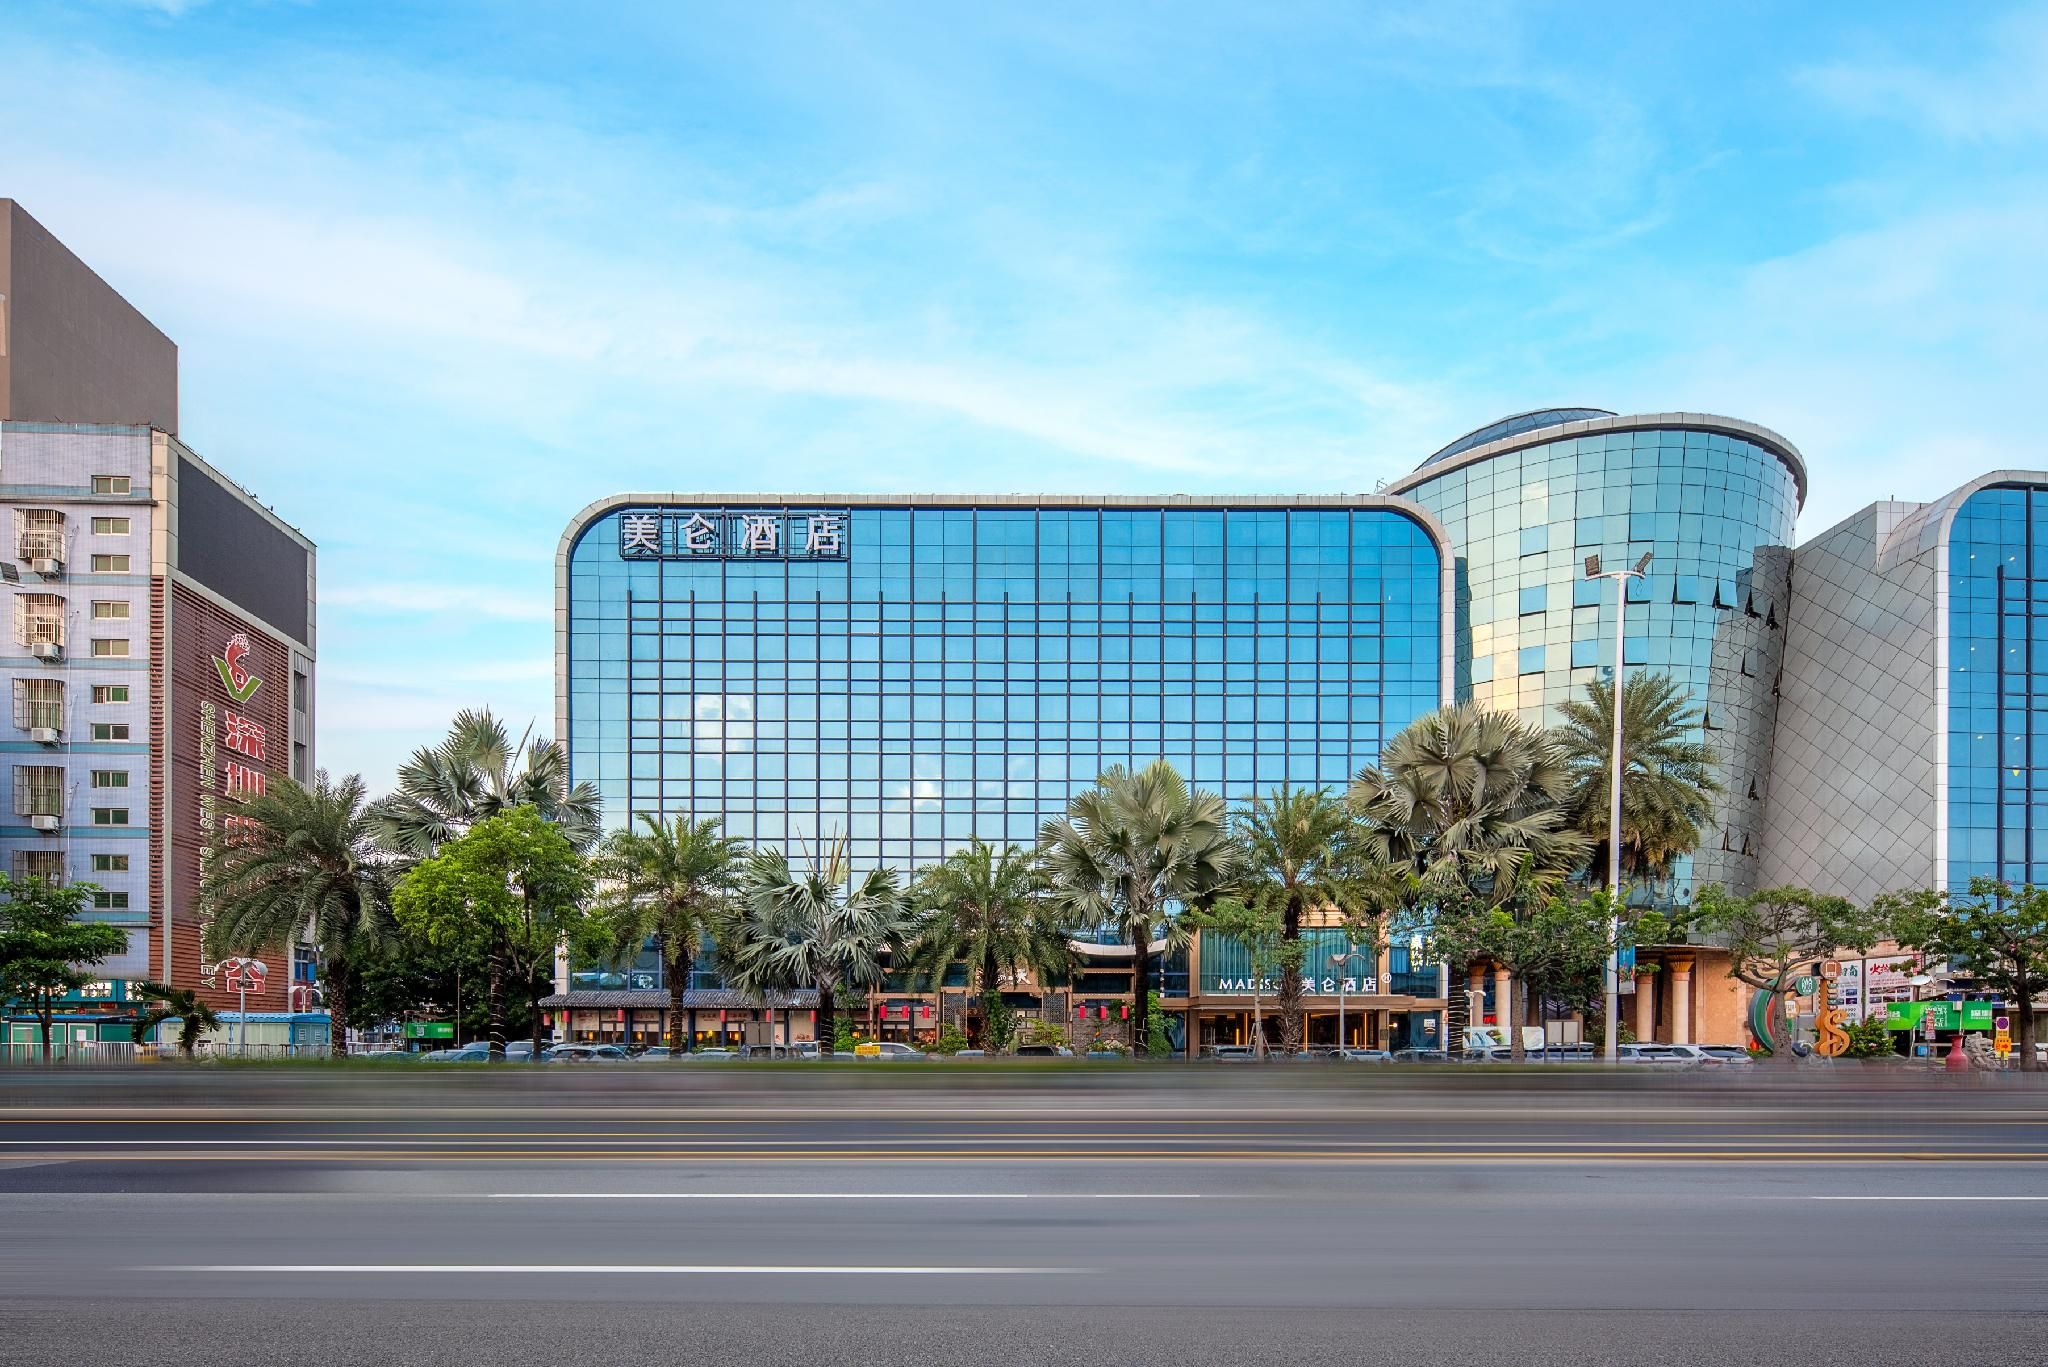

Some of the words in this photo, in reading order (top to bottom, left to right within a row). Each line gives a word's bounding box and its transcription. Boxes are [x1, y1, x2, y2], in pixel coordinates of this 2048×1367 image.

[622, 512, 842, 551] 美仑酒店
[200, 701, 216, 789] SHENZHEN
[200, 795, 216, 839] WEST
[200, 847, 216, 918] SILICN
[1218, 978, 1284, 990] MADISO
[1301, 976, 1377, 993] 美仑酒店
